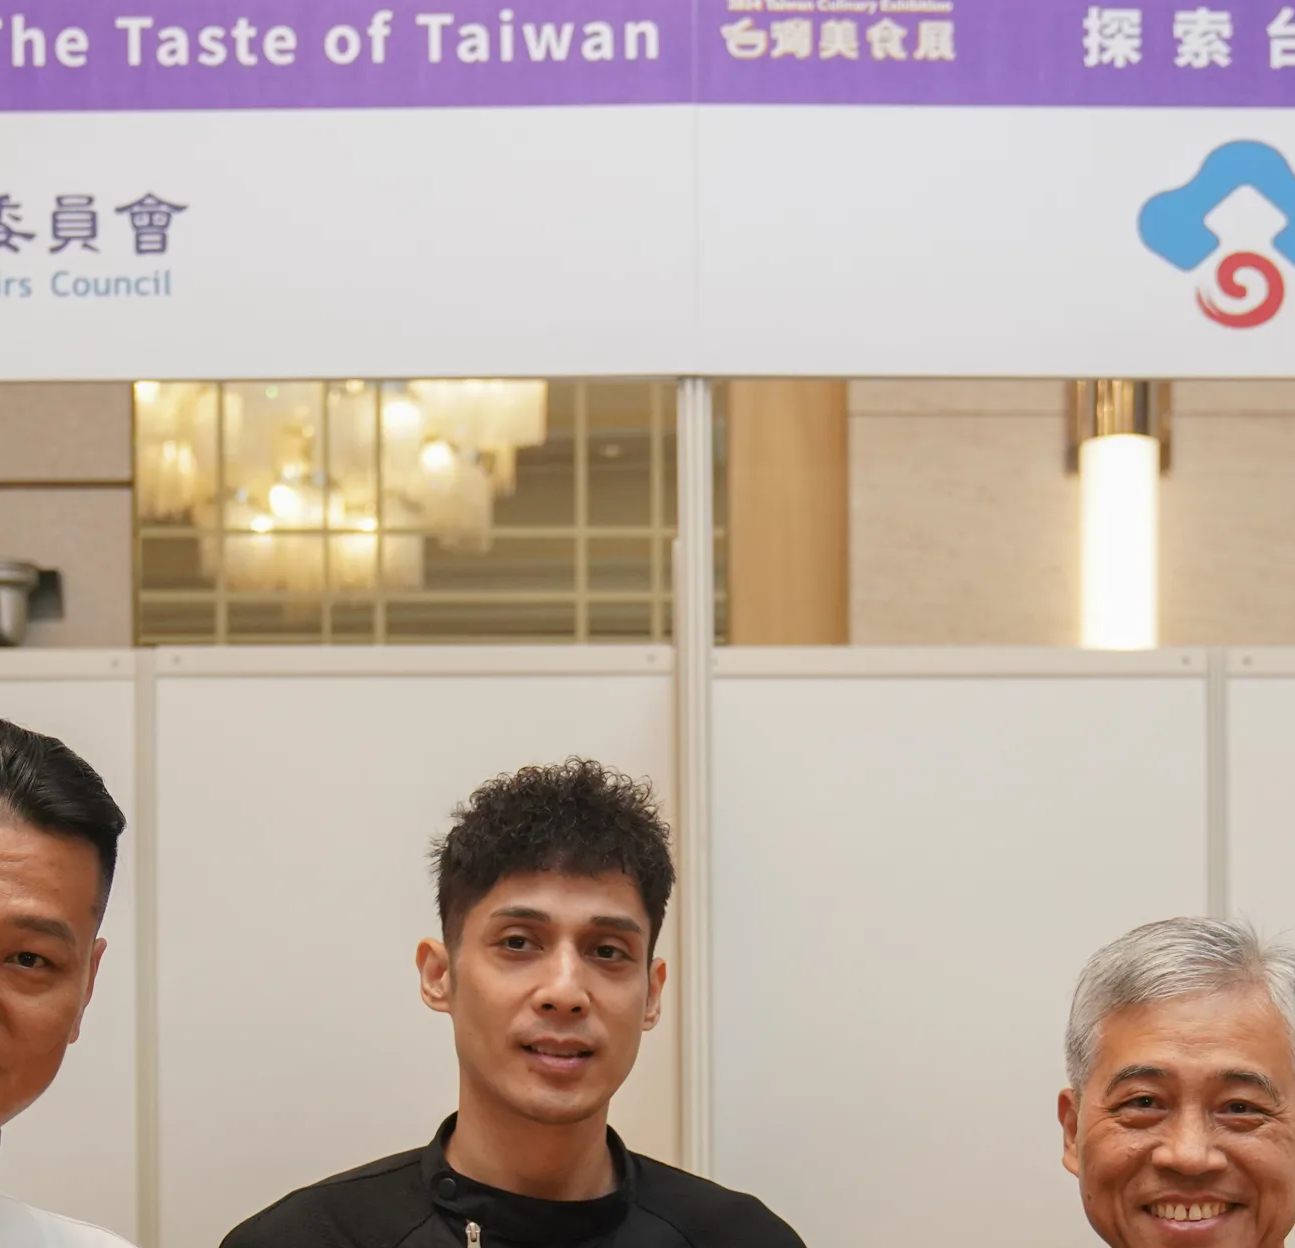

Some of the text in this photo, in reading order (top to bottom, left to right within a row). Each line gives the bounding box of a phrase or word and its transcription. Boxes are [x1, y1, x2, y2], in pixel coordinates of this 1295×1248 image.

[116, 18, 298, 67] Taste
[324, 12, 395, 65] of
[416, 11, 661, 64] Taiwan
[720, 17, 957, 61] 台灣美食展
[50, 270, 173, 299] Council
